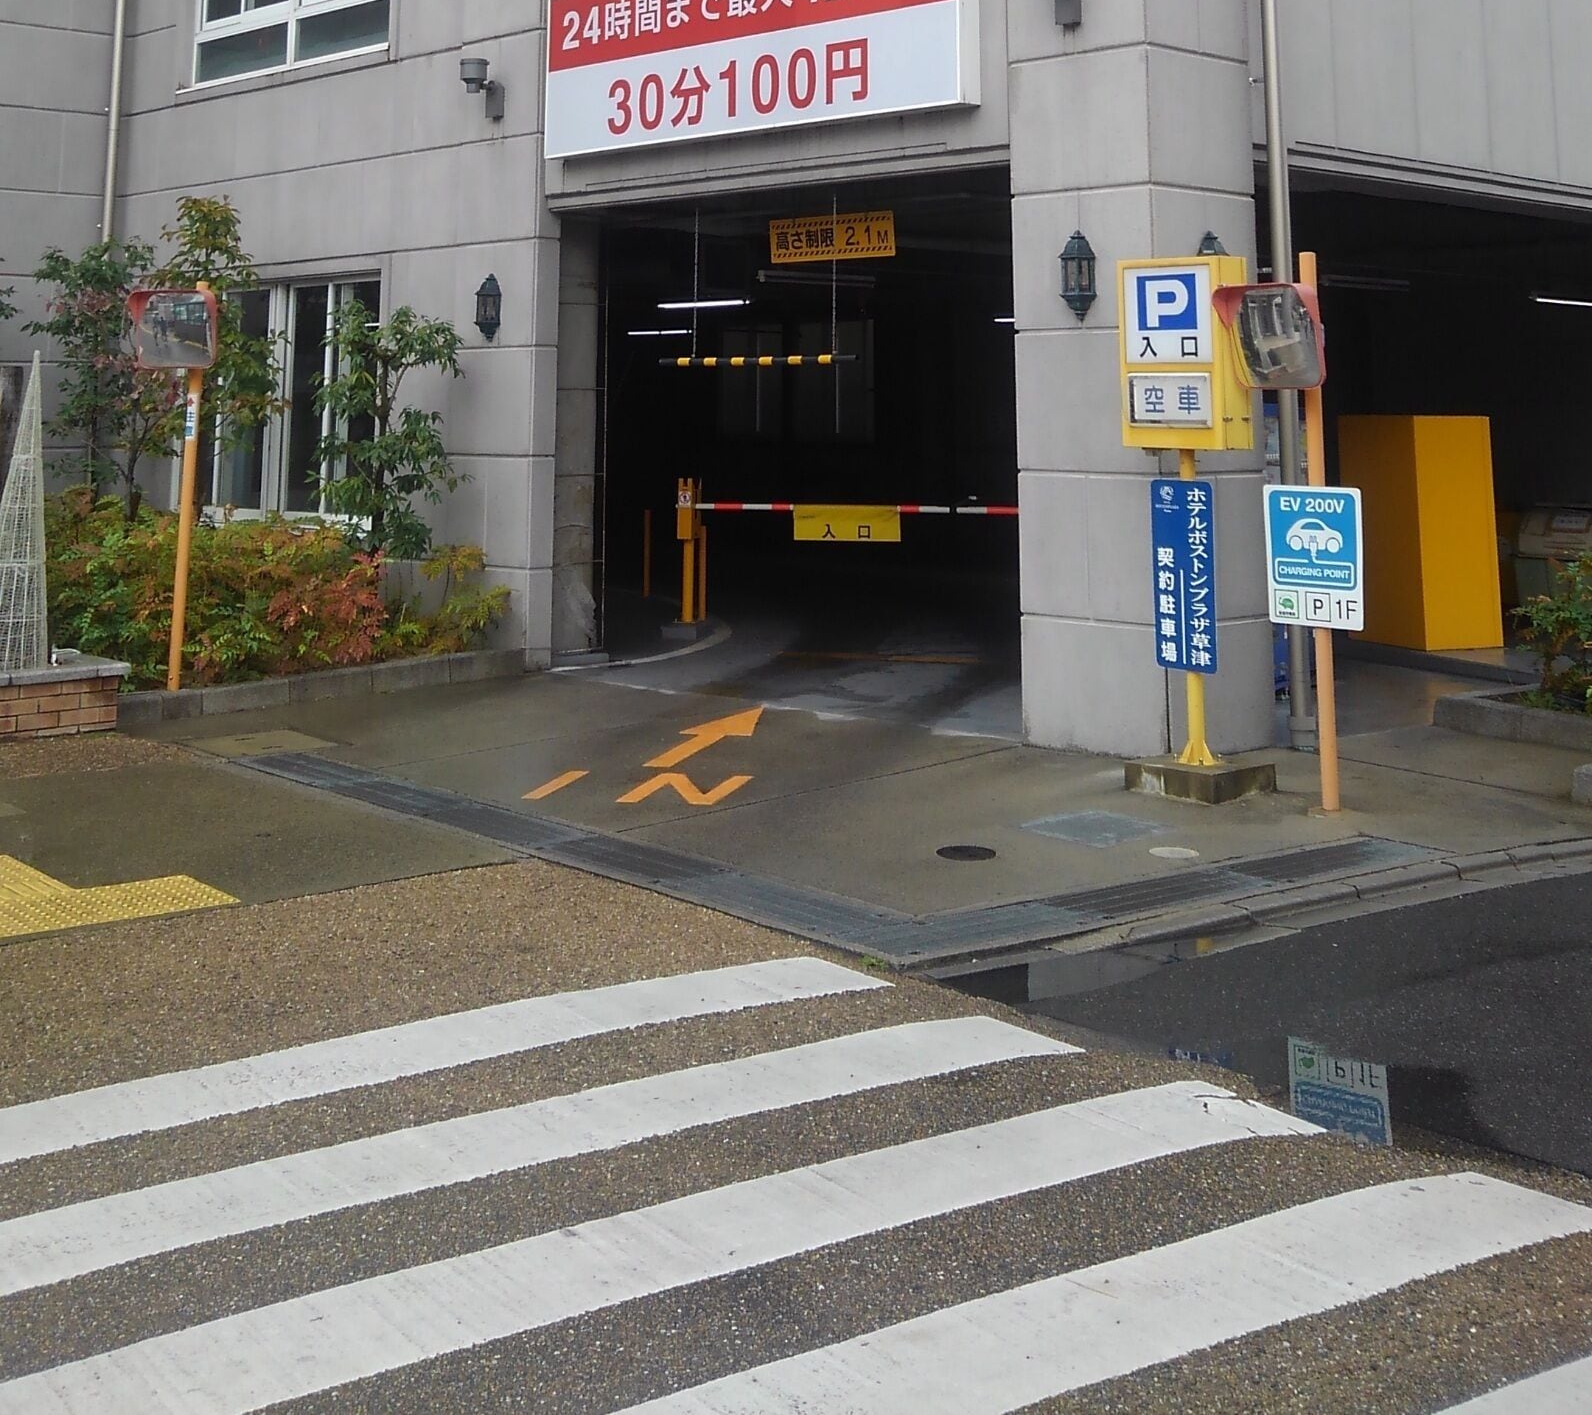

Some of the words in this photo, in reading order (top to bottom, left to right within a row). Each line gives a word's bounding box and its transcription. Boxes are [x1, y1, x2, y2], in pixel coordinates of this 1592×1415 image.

[607, 38, 869, 135] 30分100円
[775, 228, 835, 251] 高さ制限
[1145, 279, 1190, 328] P
[1139, 335, 1199, 358] 入口
[1144, 385, 1202, 415] 空車
[1280, 496, 1301, 512] EV
[1305, 498, 1345, 514] 200V
[822, 524, 871, 539] 入口
[1186, 488, 1212, 667] ホテルボストンプラザ草津
[1279, 565, 1322, 577] CHARGING
[1324, 568, 1351, 579] POINT
[1157, 547, 1178, 663] 契約駐車場
[1313, 598, 1324, 616] P
[1335, 599, 1358, 620] 1F
